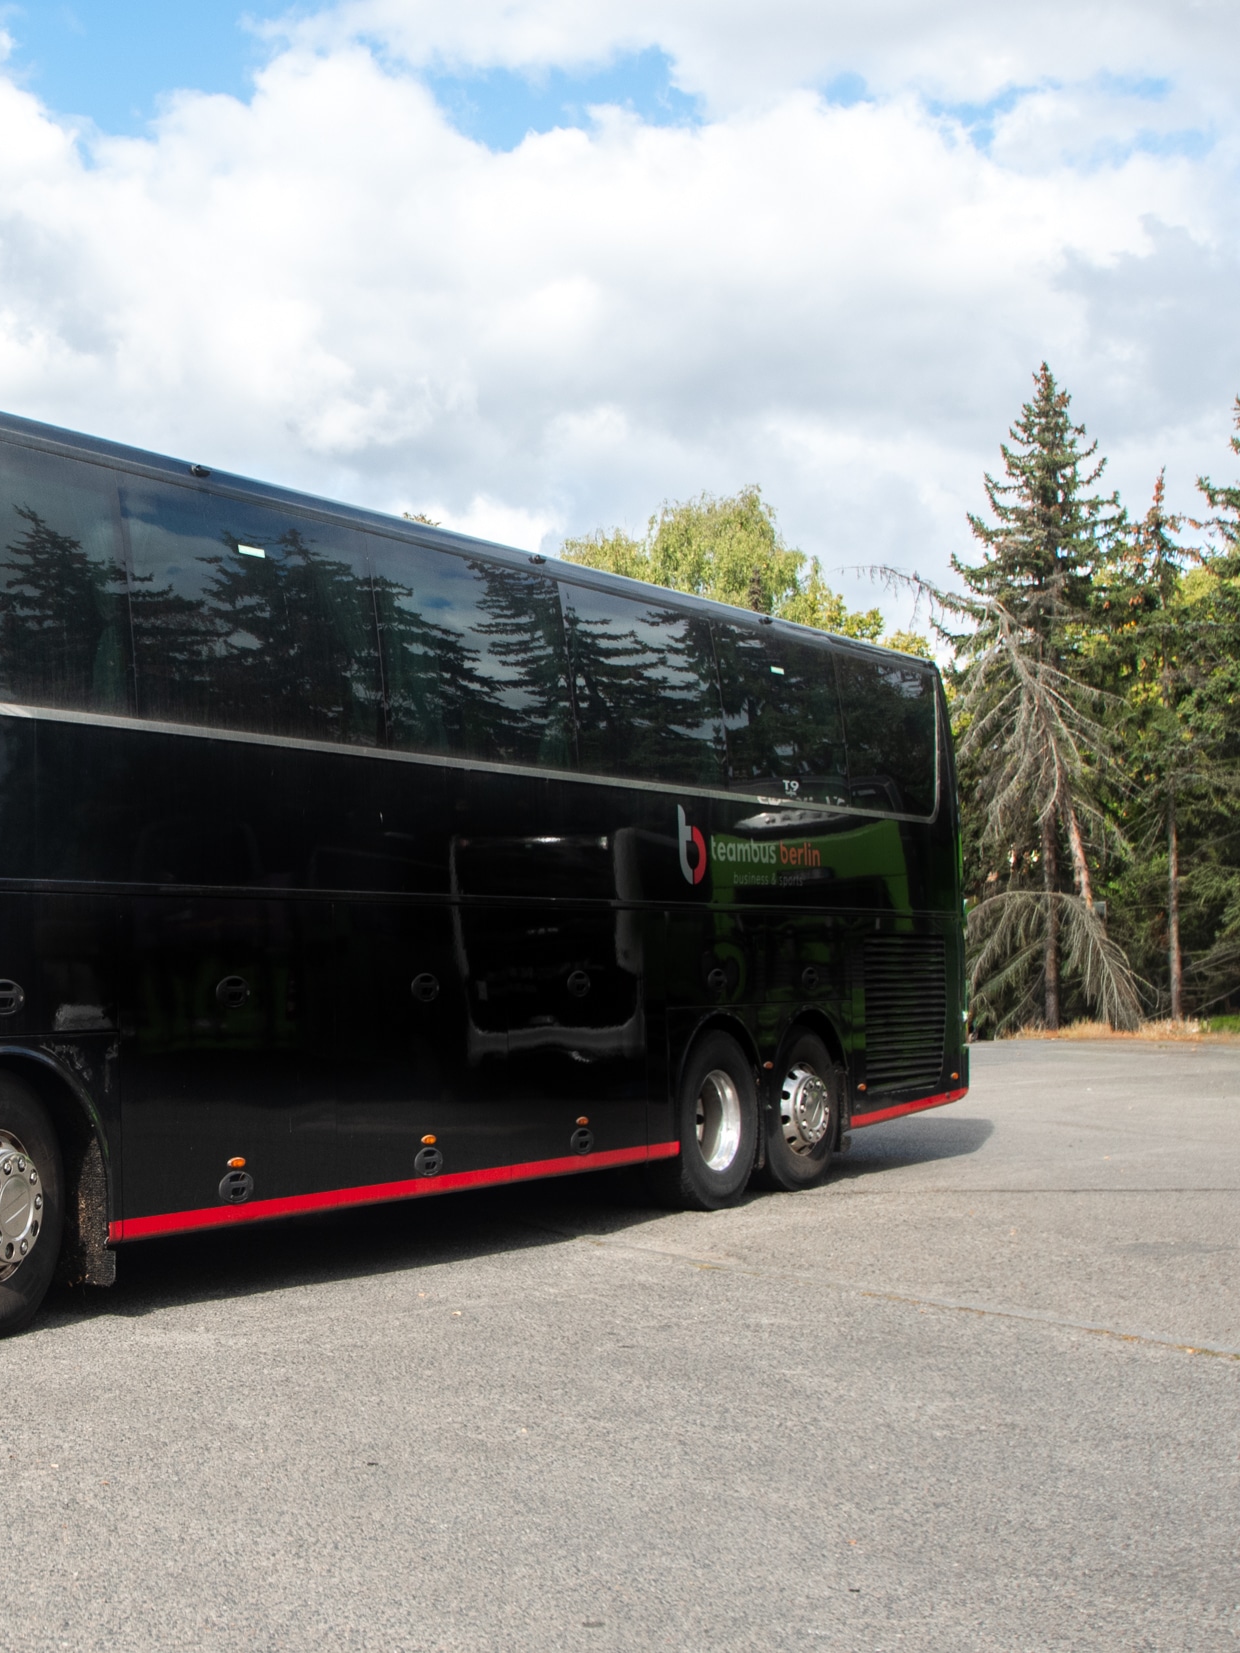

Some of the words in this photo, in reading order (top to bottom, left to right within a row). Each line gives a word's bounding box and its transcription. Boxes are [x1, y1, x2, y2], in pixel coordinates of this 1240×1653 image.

[782, 779, 800, 792] T9
[711, 834, 777, 864] teambus
[779, 840, 822, 867] berlin
[733, 872, 769, 886] business
[771, 872, 777, 885] &
[779, 874, 804, 887] sports
